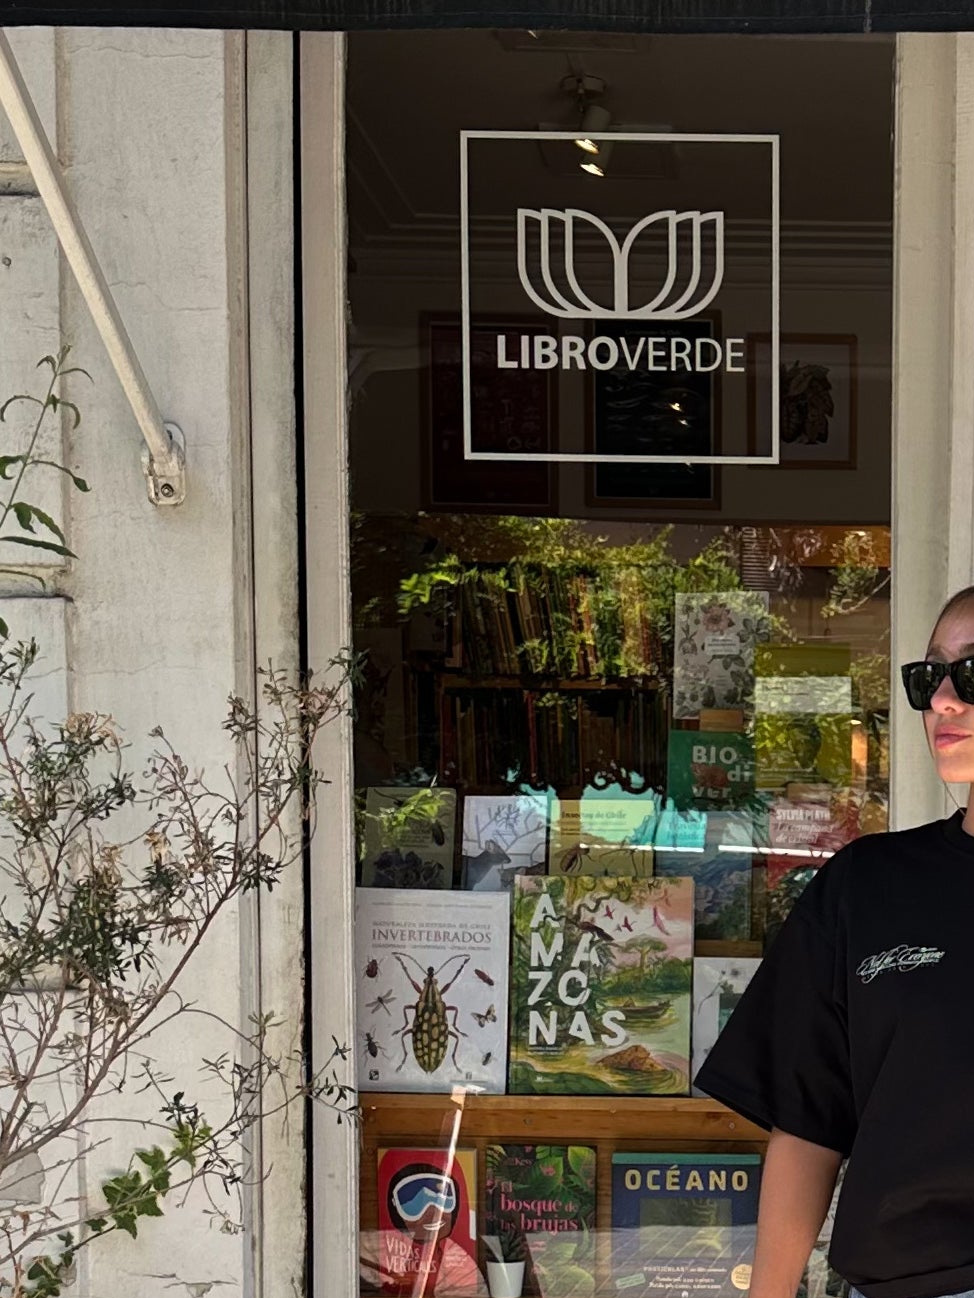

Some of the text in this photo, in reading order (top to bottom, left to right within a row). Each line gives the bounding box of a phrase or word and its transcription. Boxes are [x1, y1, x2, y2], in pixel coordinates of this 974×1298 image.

[496, 334, 745, 372] LIBROVERDE
[692, 745, 737, 765] BIO
[371, 928, 492, 944] INVERTEBRADOS
[624, 1164, 749, 1192] OCÉANO
[500, 1194, 578, 1216] bosque de
[520, 1213, 578, 1236] brujas
[385, 1235, 421, 1260] VIDAS
